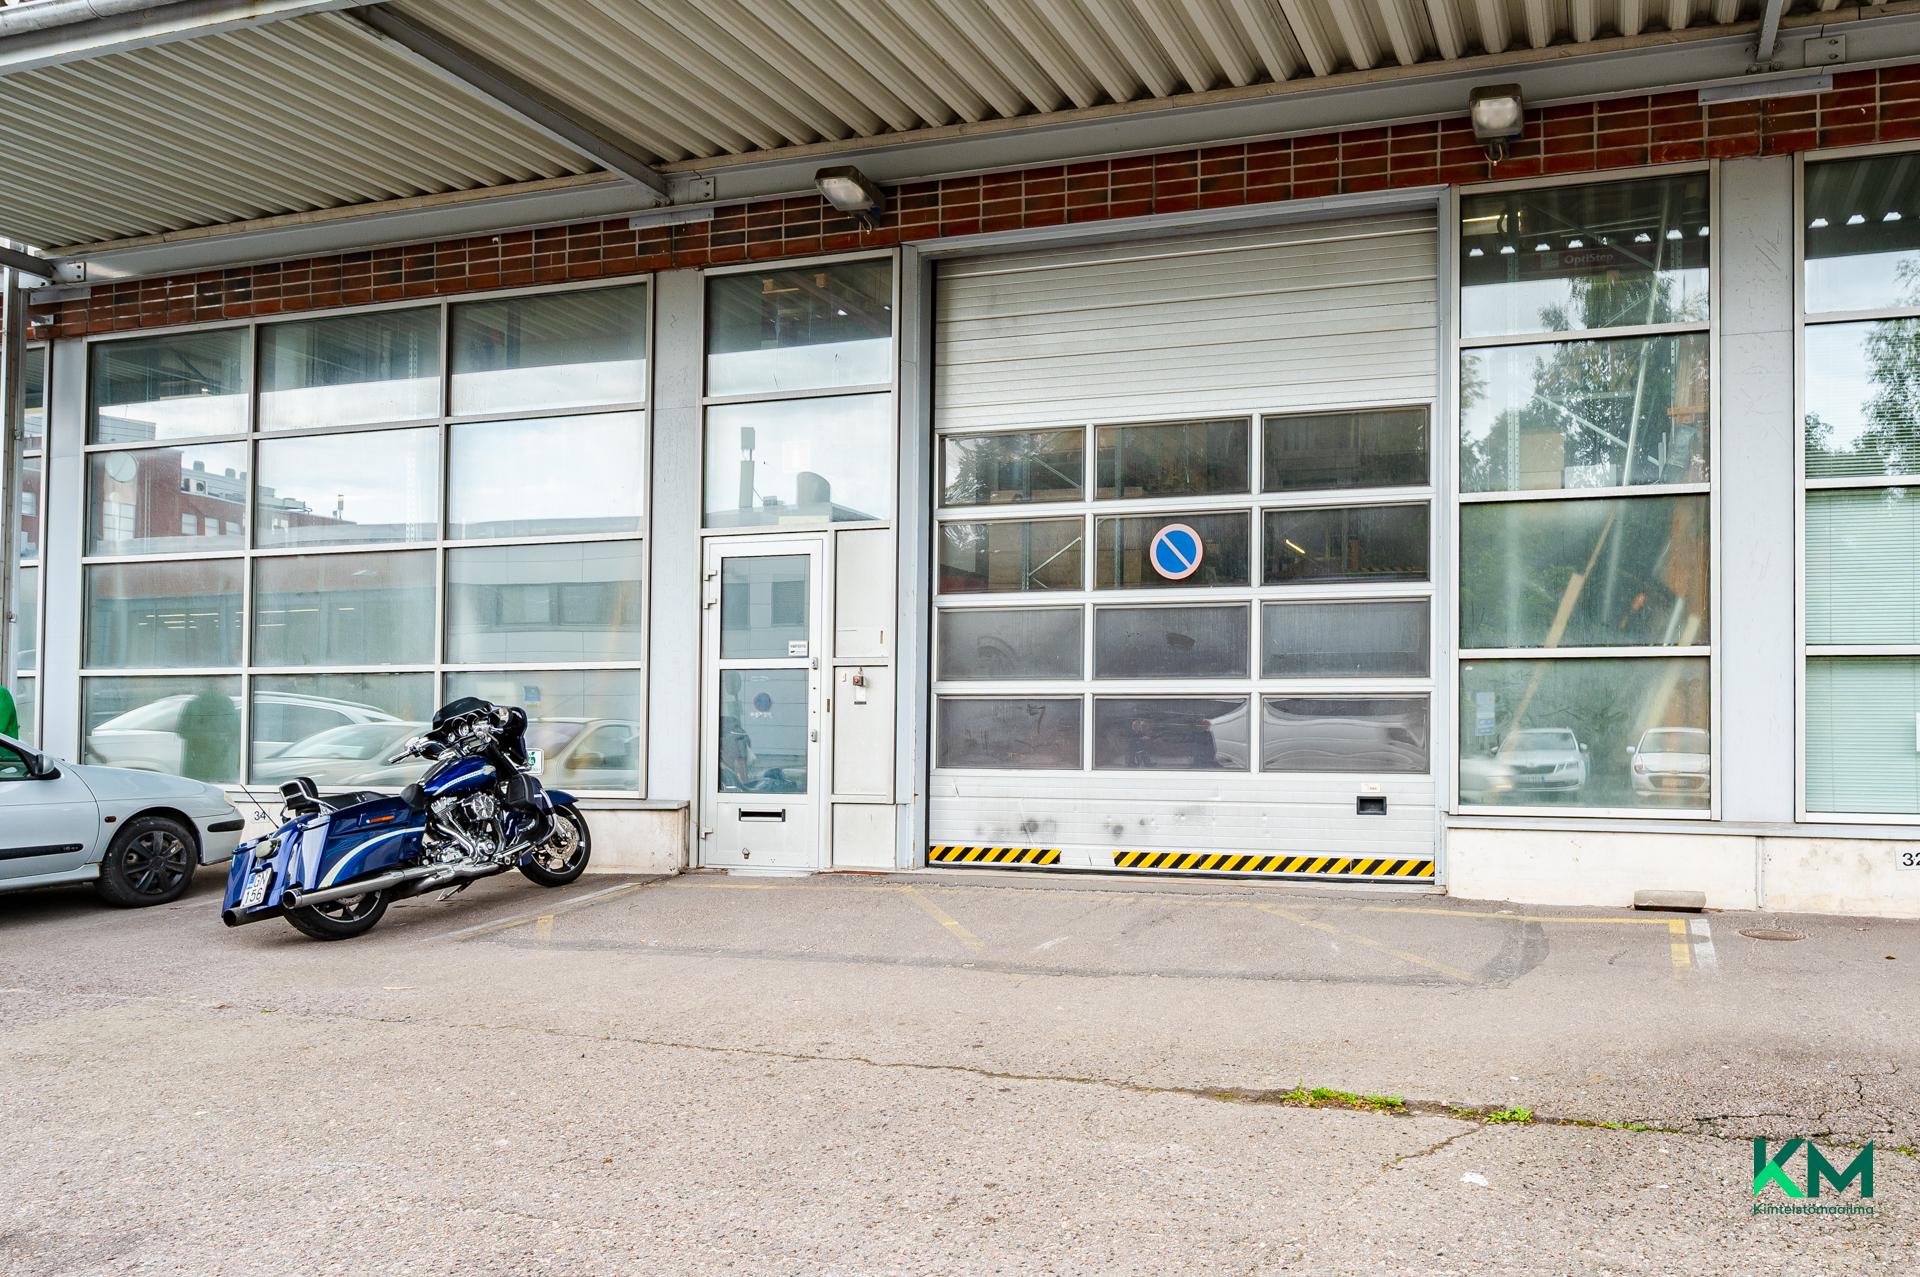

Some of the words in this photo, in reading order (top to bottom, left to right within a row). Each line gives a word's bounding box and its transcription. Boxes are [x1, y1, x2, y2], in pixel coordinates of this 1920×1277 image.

[1564, 253, 1614, 266] OptiStep
[254, 810, 267, 821] 34
[243, 887, 263, 905] 156
